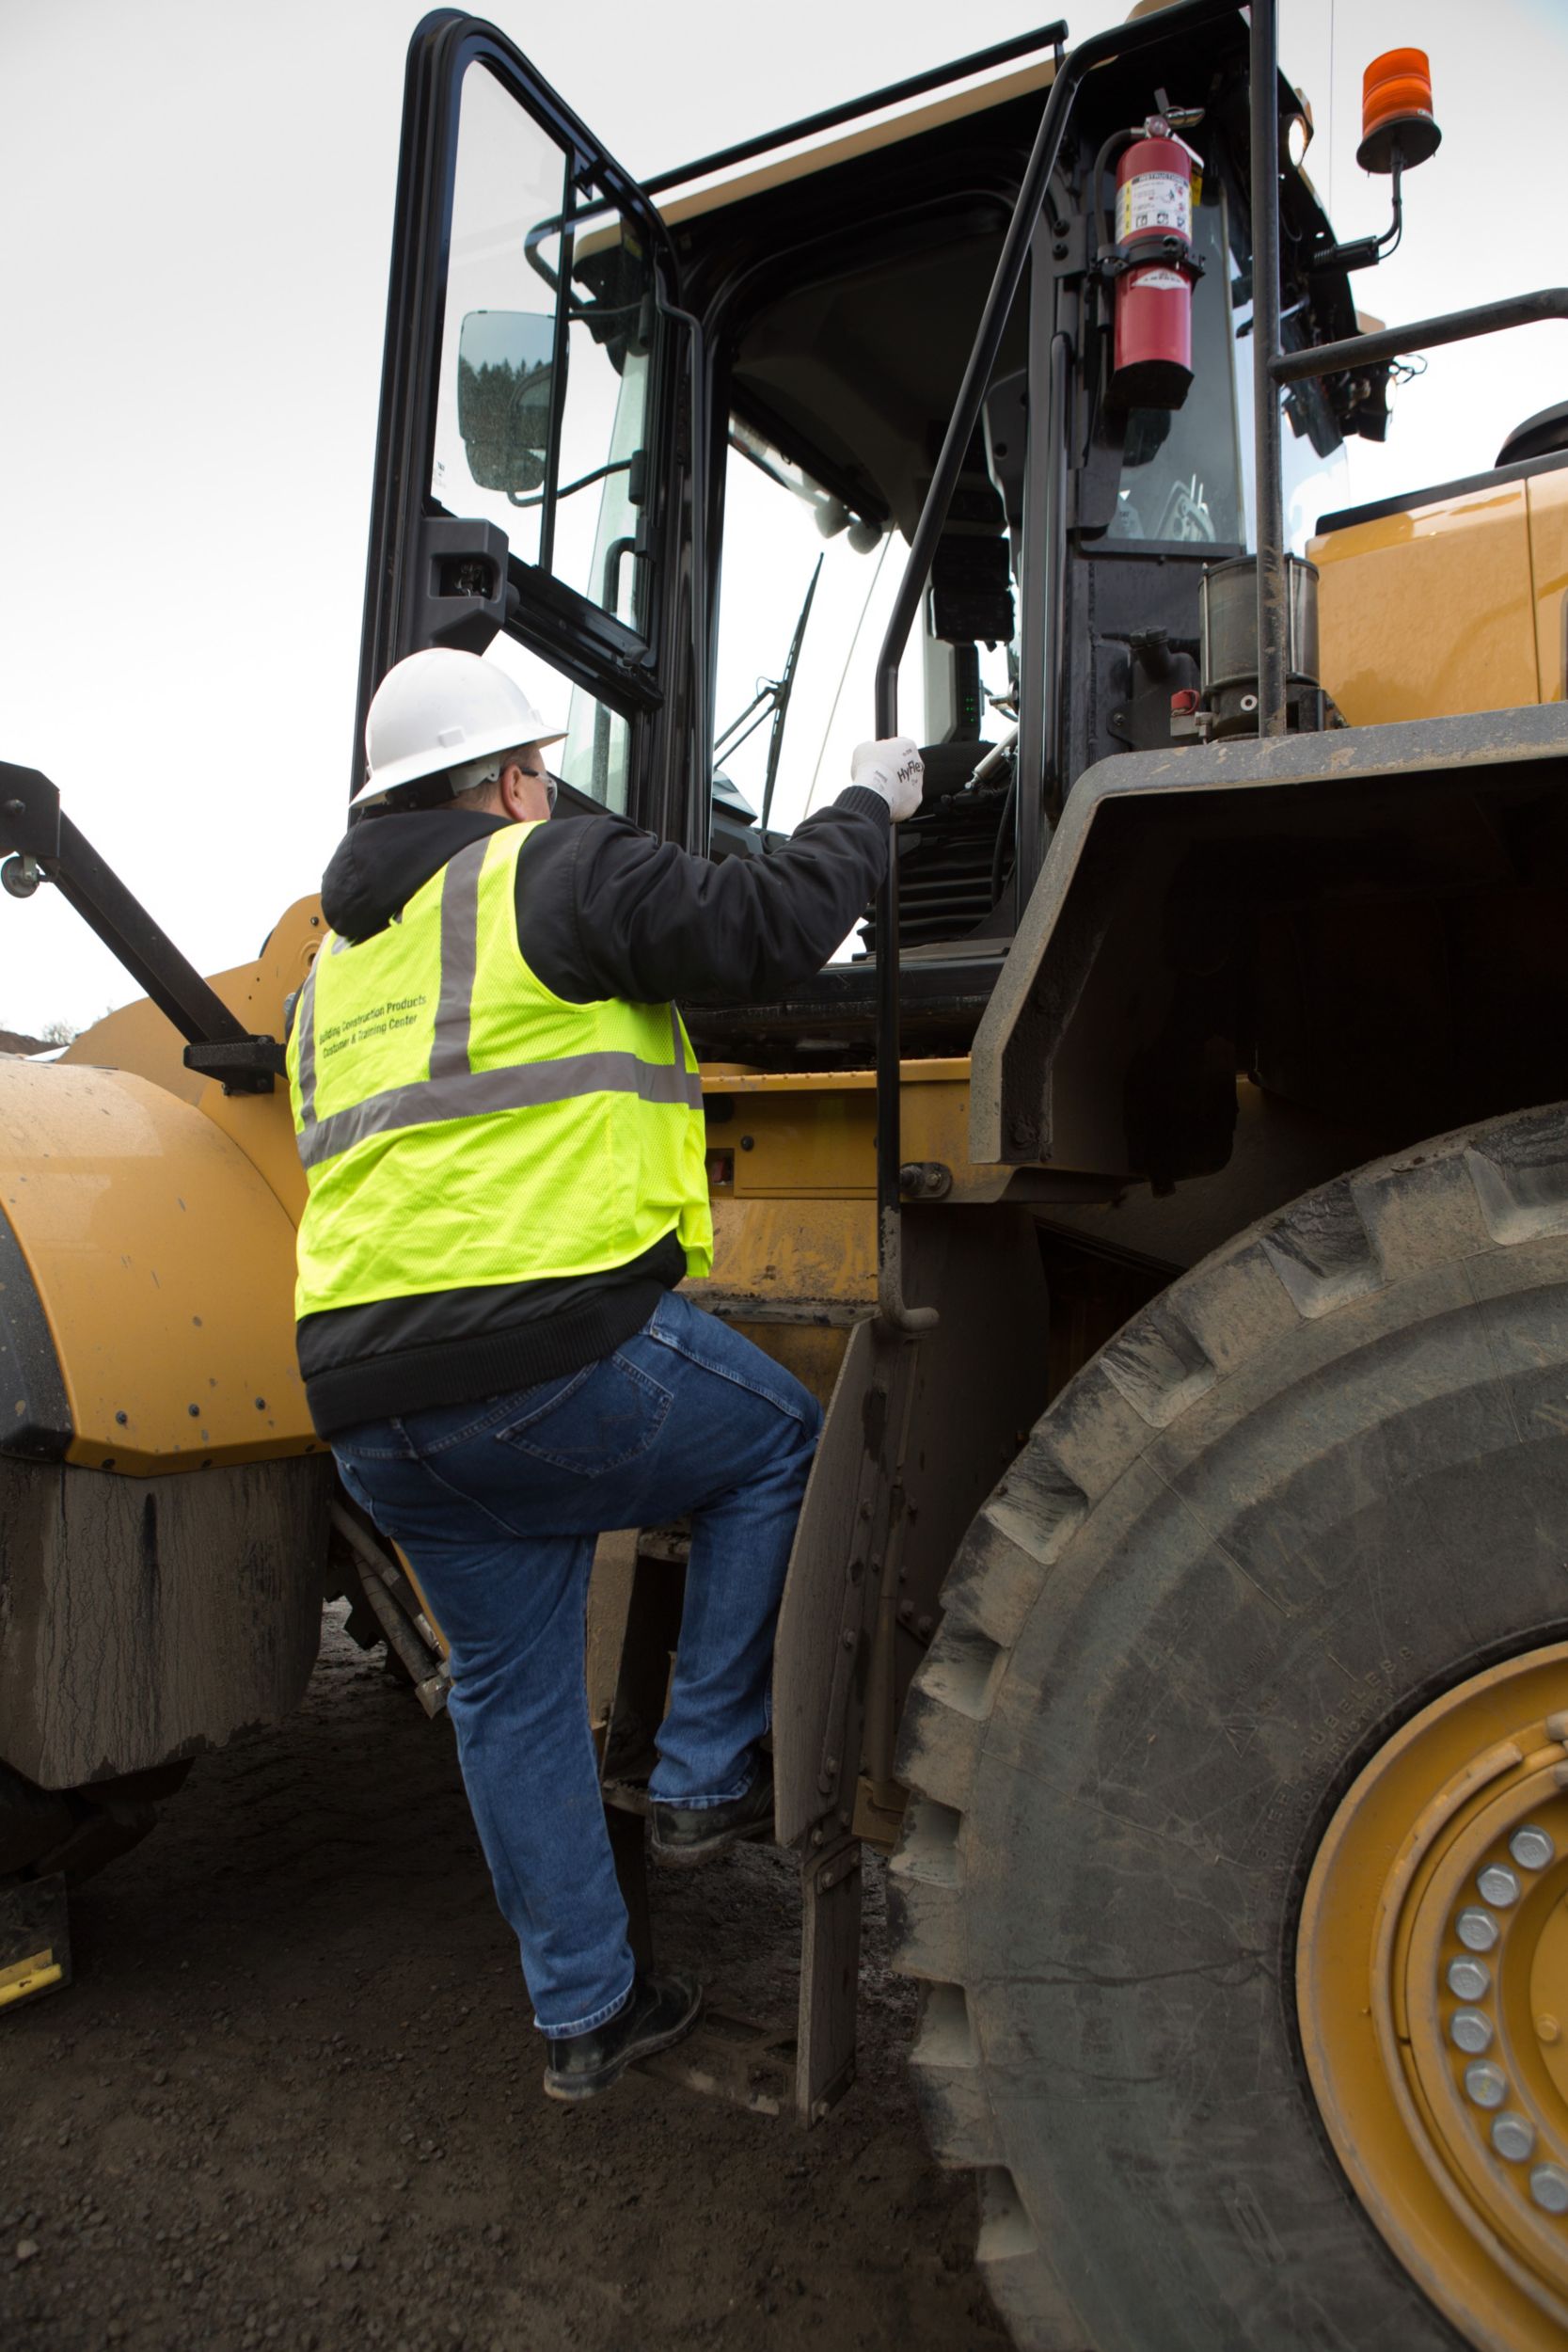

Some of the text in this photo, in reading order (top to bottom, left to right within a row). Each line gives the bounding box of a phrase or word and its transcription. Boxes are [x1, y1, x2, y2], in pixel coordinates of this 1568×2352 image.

[342, 1008, 385, 1032] Construction
[387, 994, 426, 1014] Products
[324, 1015, 417, 1058] Customer & Training Center
[1300, 1645, 1414, 1762] TUBELESS
